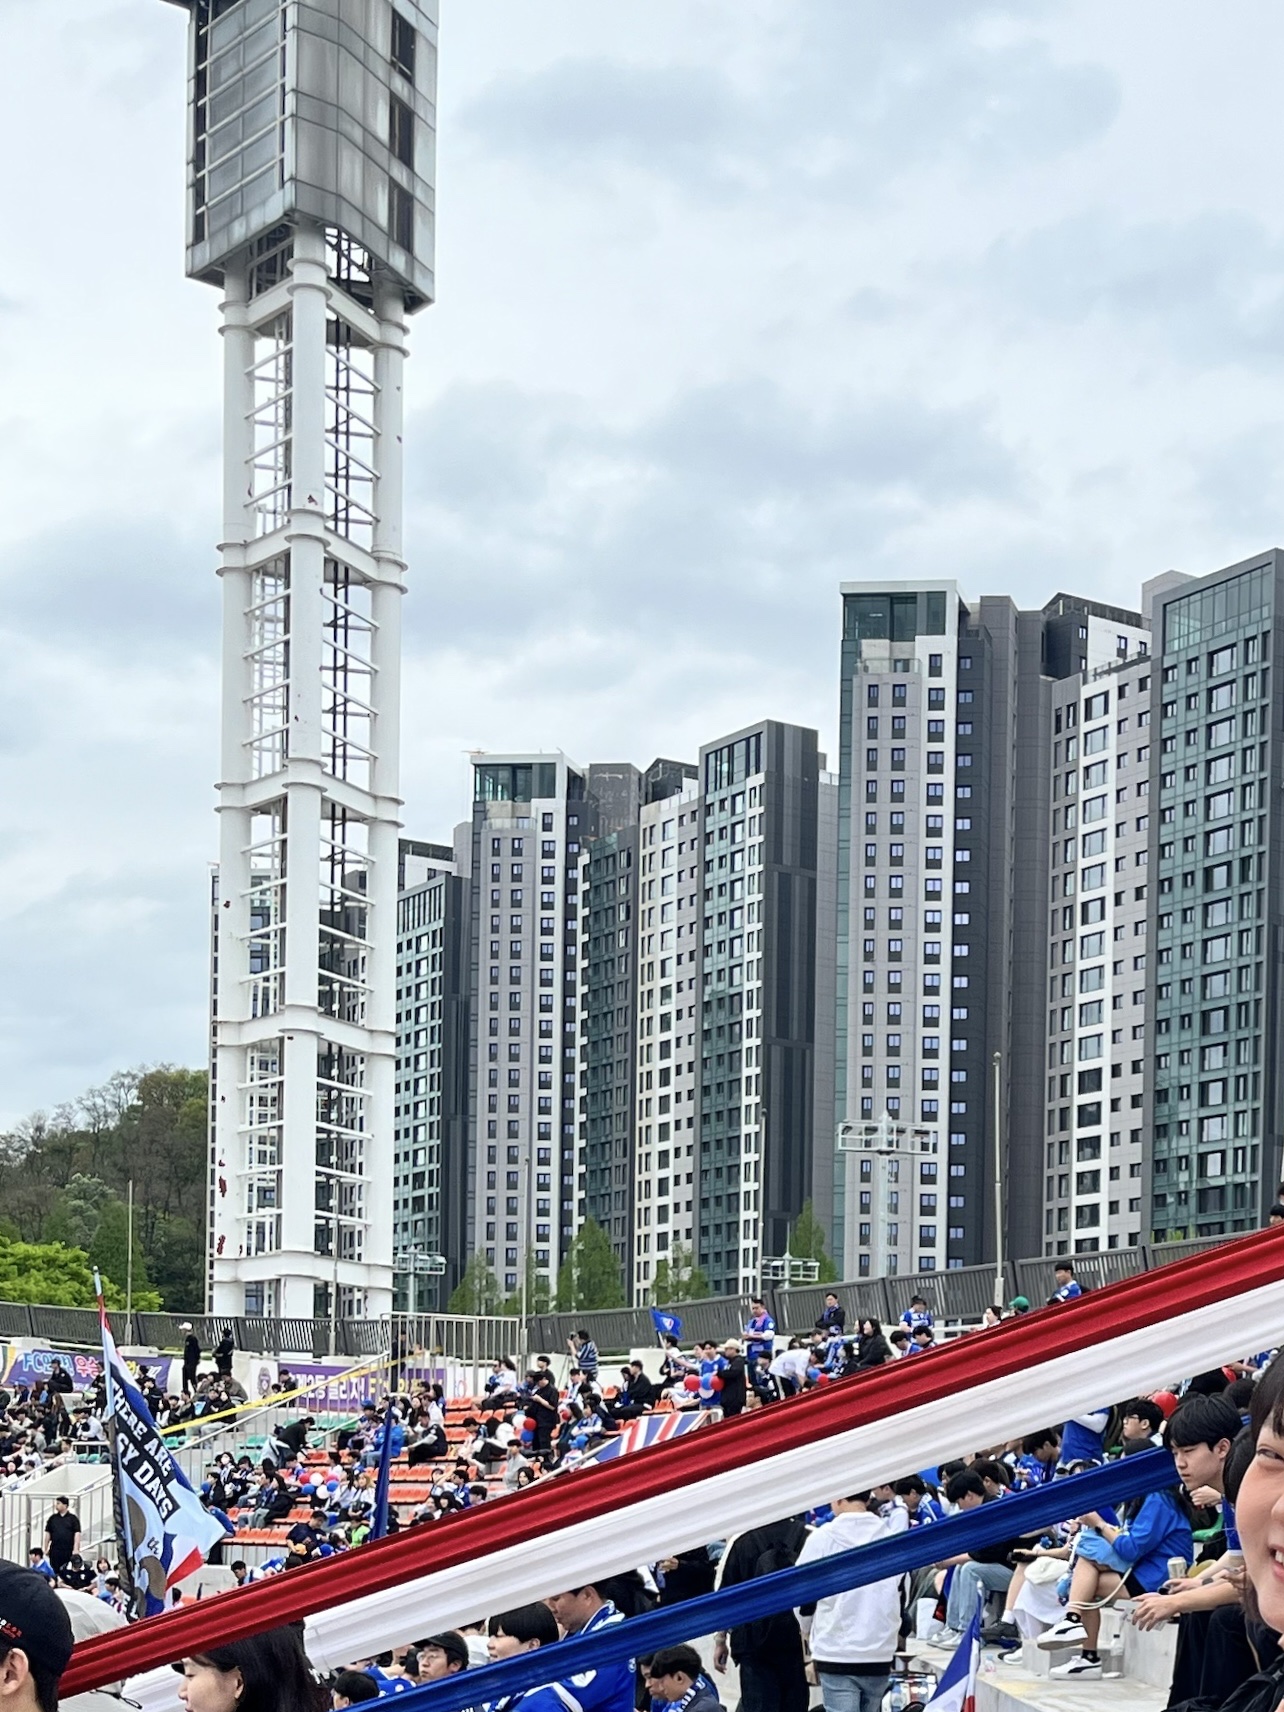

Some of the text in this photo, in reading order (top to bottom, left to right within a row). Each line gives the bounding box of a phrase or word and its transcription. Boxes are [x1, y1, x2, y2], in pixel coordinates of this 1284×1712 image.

[111, 1377, 148, 1441] THERE
[143, 1437, 175, 1478] ARE
[133, 1460, 173, 1520] DAYS
